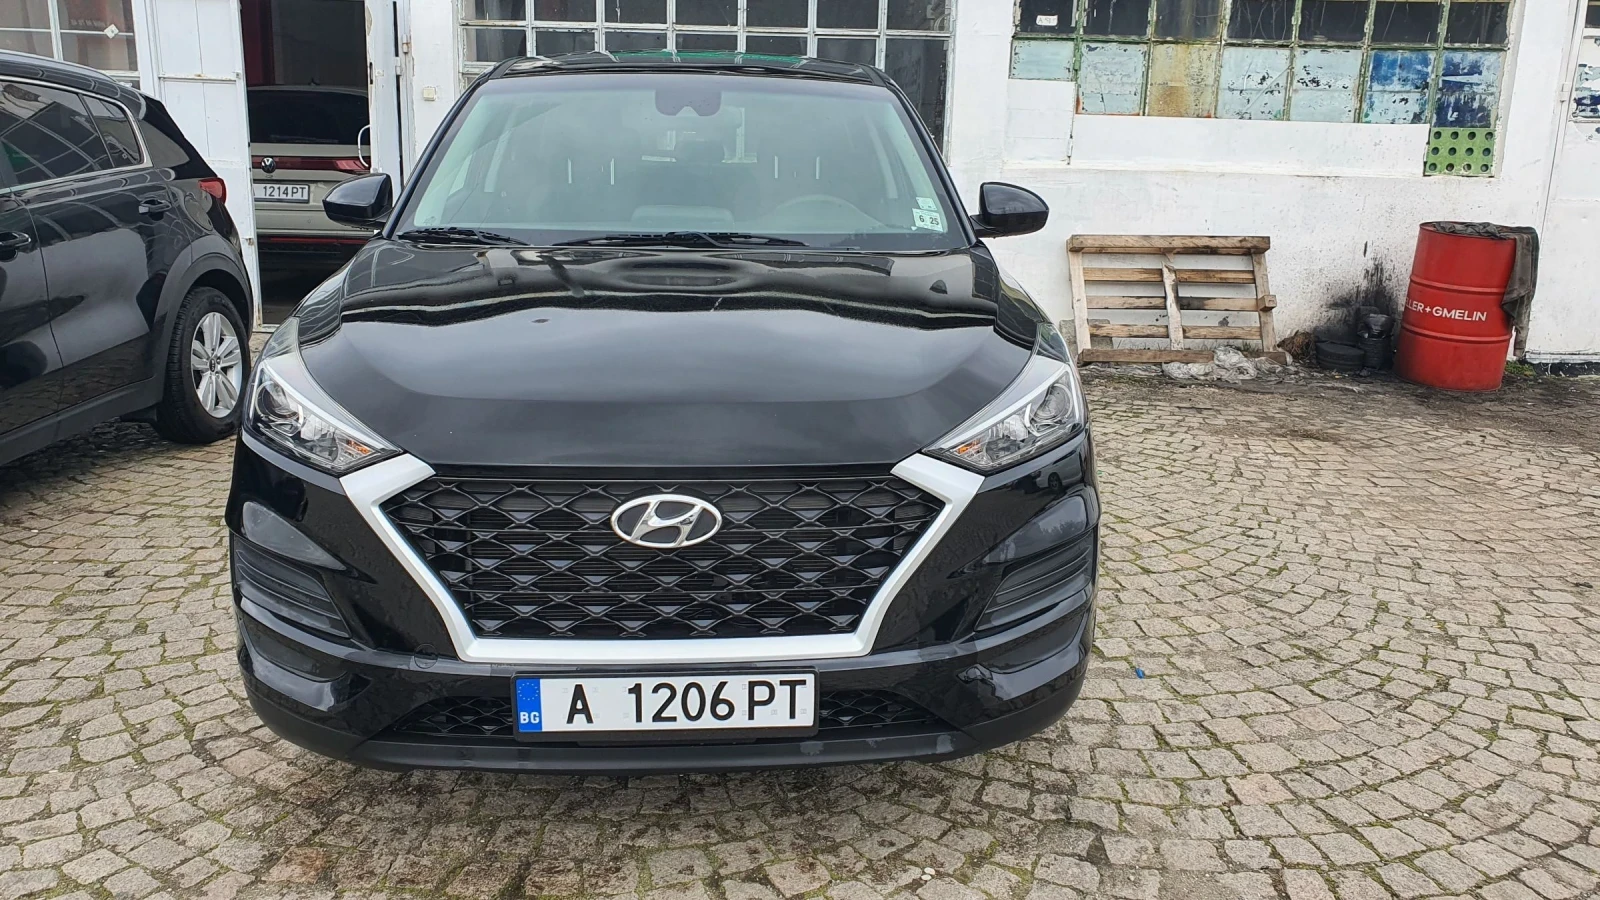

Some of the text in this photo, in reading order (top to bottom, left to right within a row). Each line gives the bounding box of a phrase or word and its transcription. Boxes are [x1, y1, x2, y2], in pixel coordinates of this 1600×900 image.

[263, 185, 289, 198] 1214
[291, 186, 306, 198] PT
[919, 214, 939, 226] 6 25
[566, 679, 807, 724] A 1206 PT
[519, 711, 540, 724] BG
